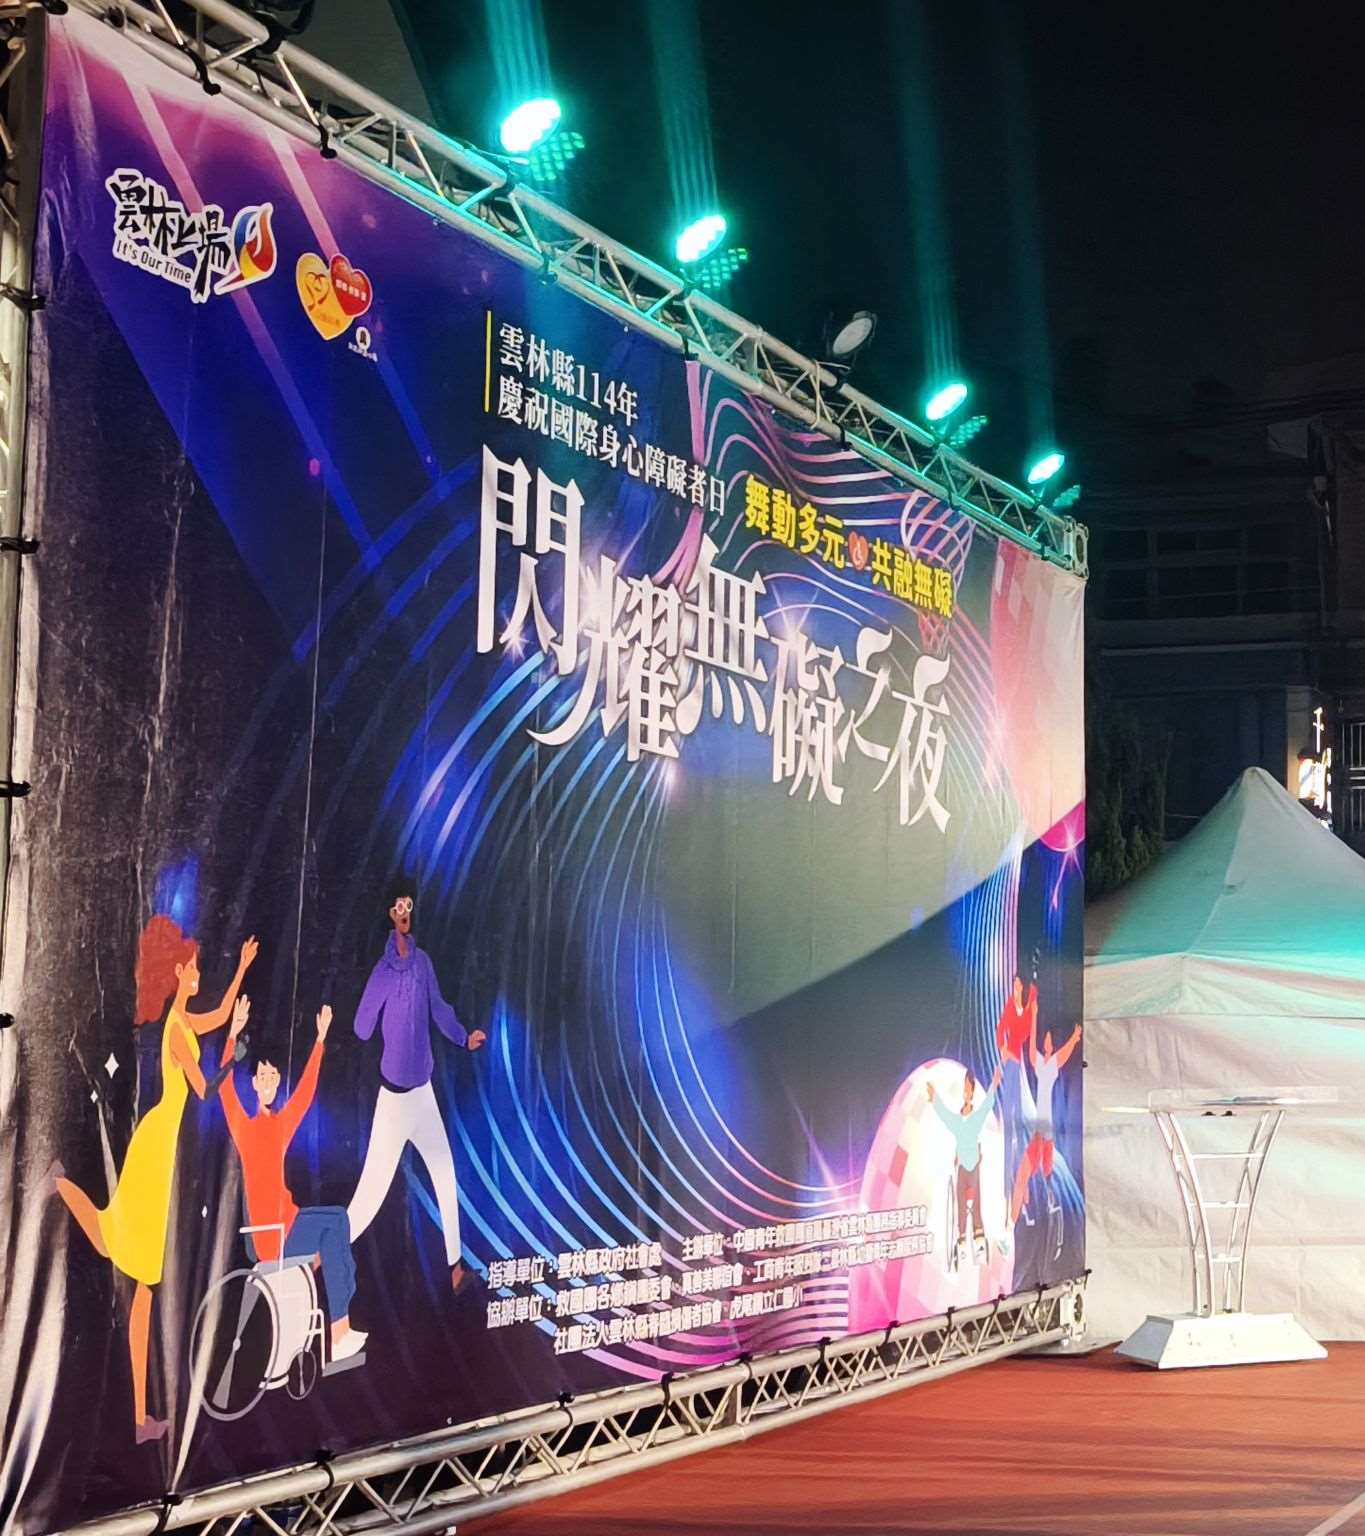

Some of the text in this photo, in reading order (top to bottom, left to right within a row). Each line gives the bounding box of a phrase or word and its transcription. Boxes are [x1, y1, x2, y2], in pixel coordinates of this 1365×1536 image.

[116, 240, 192, 283] It's Our Time
[499, 322, 639, 427] 雲林縣114年
[497, 375, 726, 517] 慶祝國際身心障礙者日
[744, 473, 954, 619] 舞動多元 共融無礙
[475, 443, 953, 834] 閃耀無礙之夜
